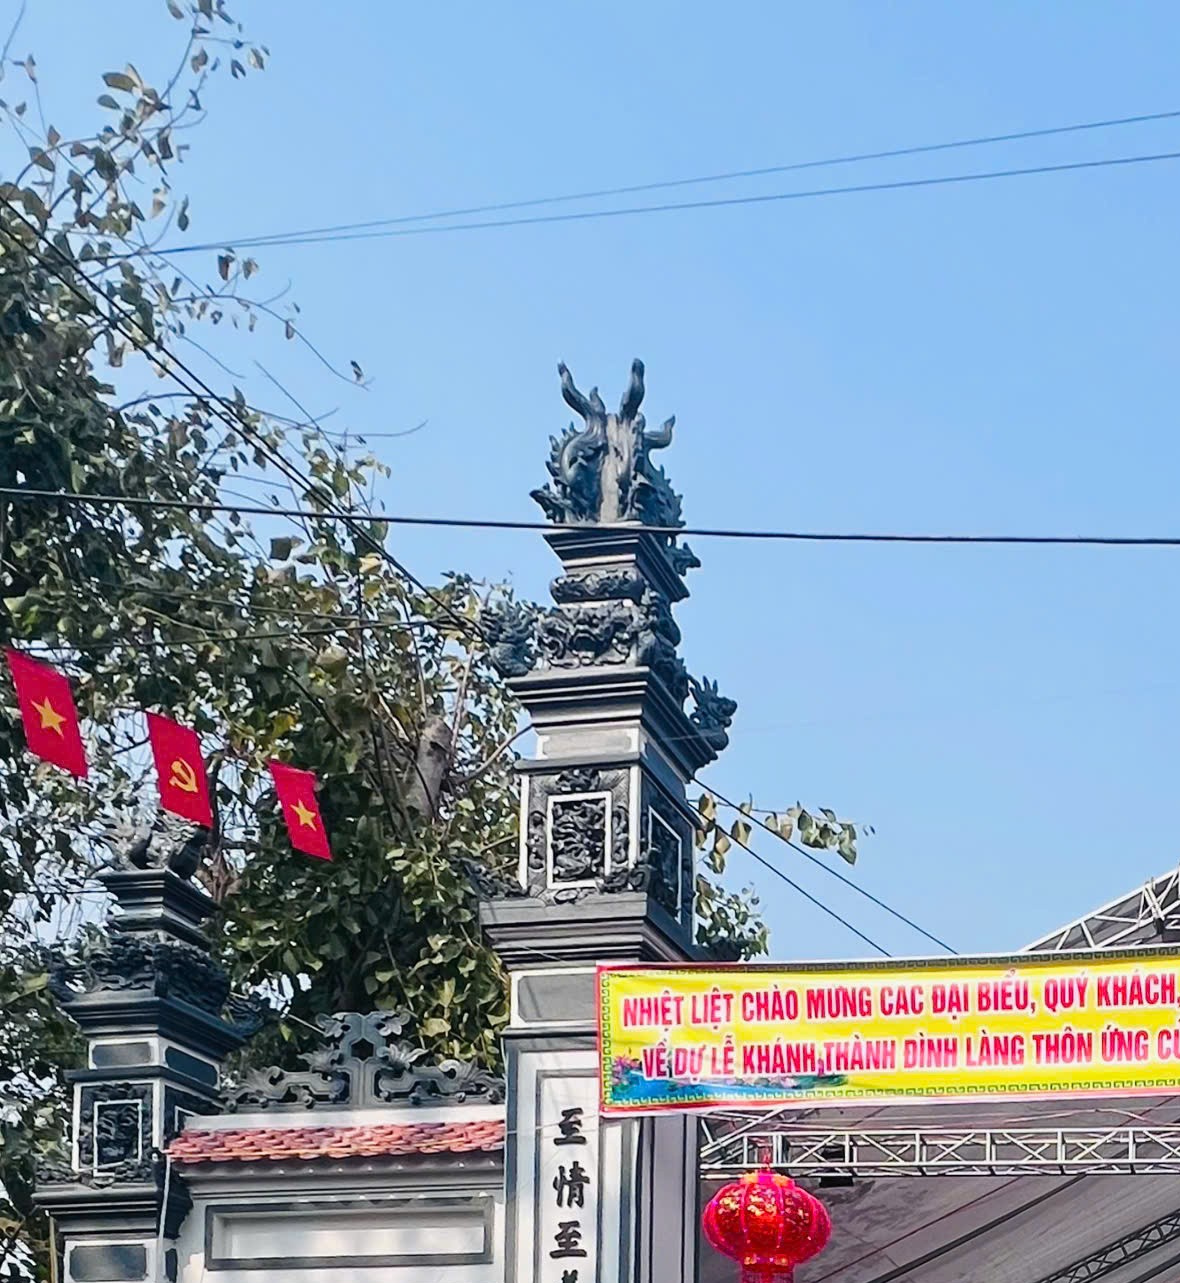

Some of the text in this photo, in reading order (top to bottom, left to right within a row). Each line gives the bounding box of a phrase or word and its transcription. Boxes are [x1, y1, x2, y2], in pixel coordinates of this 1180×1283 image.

[623, 990, 684, 1032] NHIỆT
[691, 987, 734, 1030] LIỆT
[742, 984, 799, 1022] CHÀO
[932, 983, 970, 1020] ĐẠI
[977, 969, 1036, 1014] BIỂU,
[1044, 971, 1088, 1012] QUÝ
[643, 1038, 668, 1078] VỀ
[674, 1044, 706, 1081] DỰ
[711, 1034, 735, 1075] LỄ
[743, 1037, 816, 1074] KHÁNH
[823, 1034, 896, 1073] THÀNH
[903, 1032, 958, 1069] ĐÌNH
[966, 1029, 1025, 1067] LÀNG
[1032, 1026, 1092, 1064] THÔN
[1101, 1024, 1149, 1062] ỨNG
